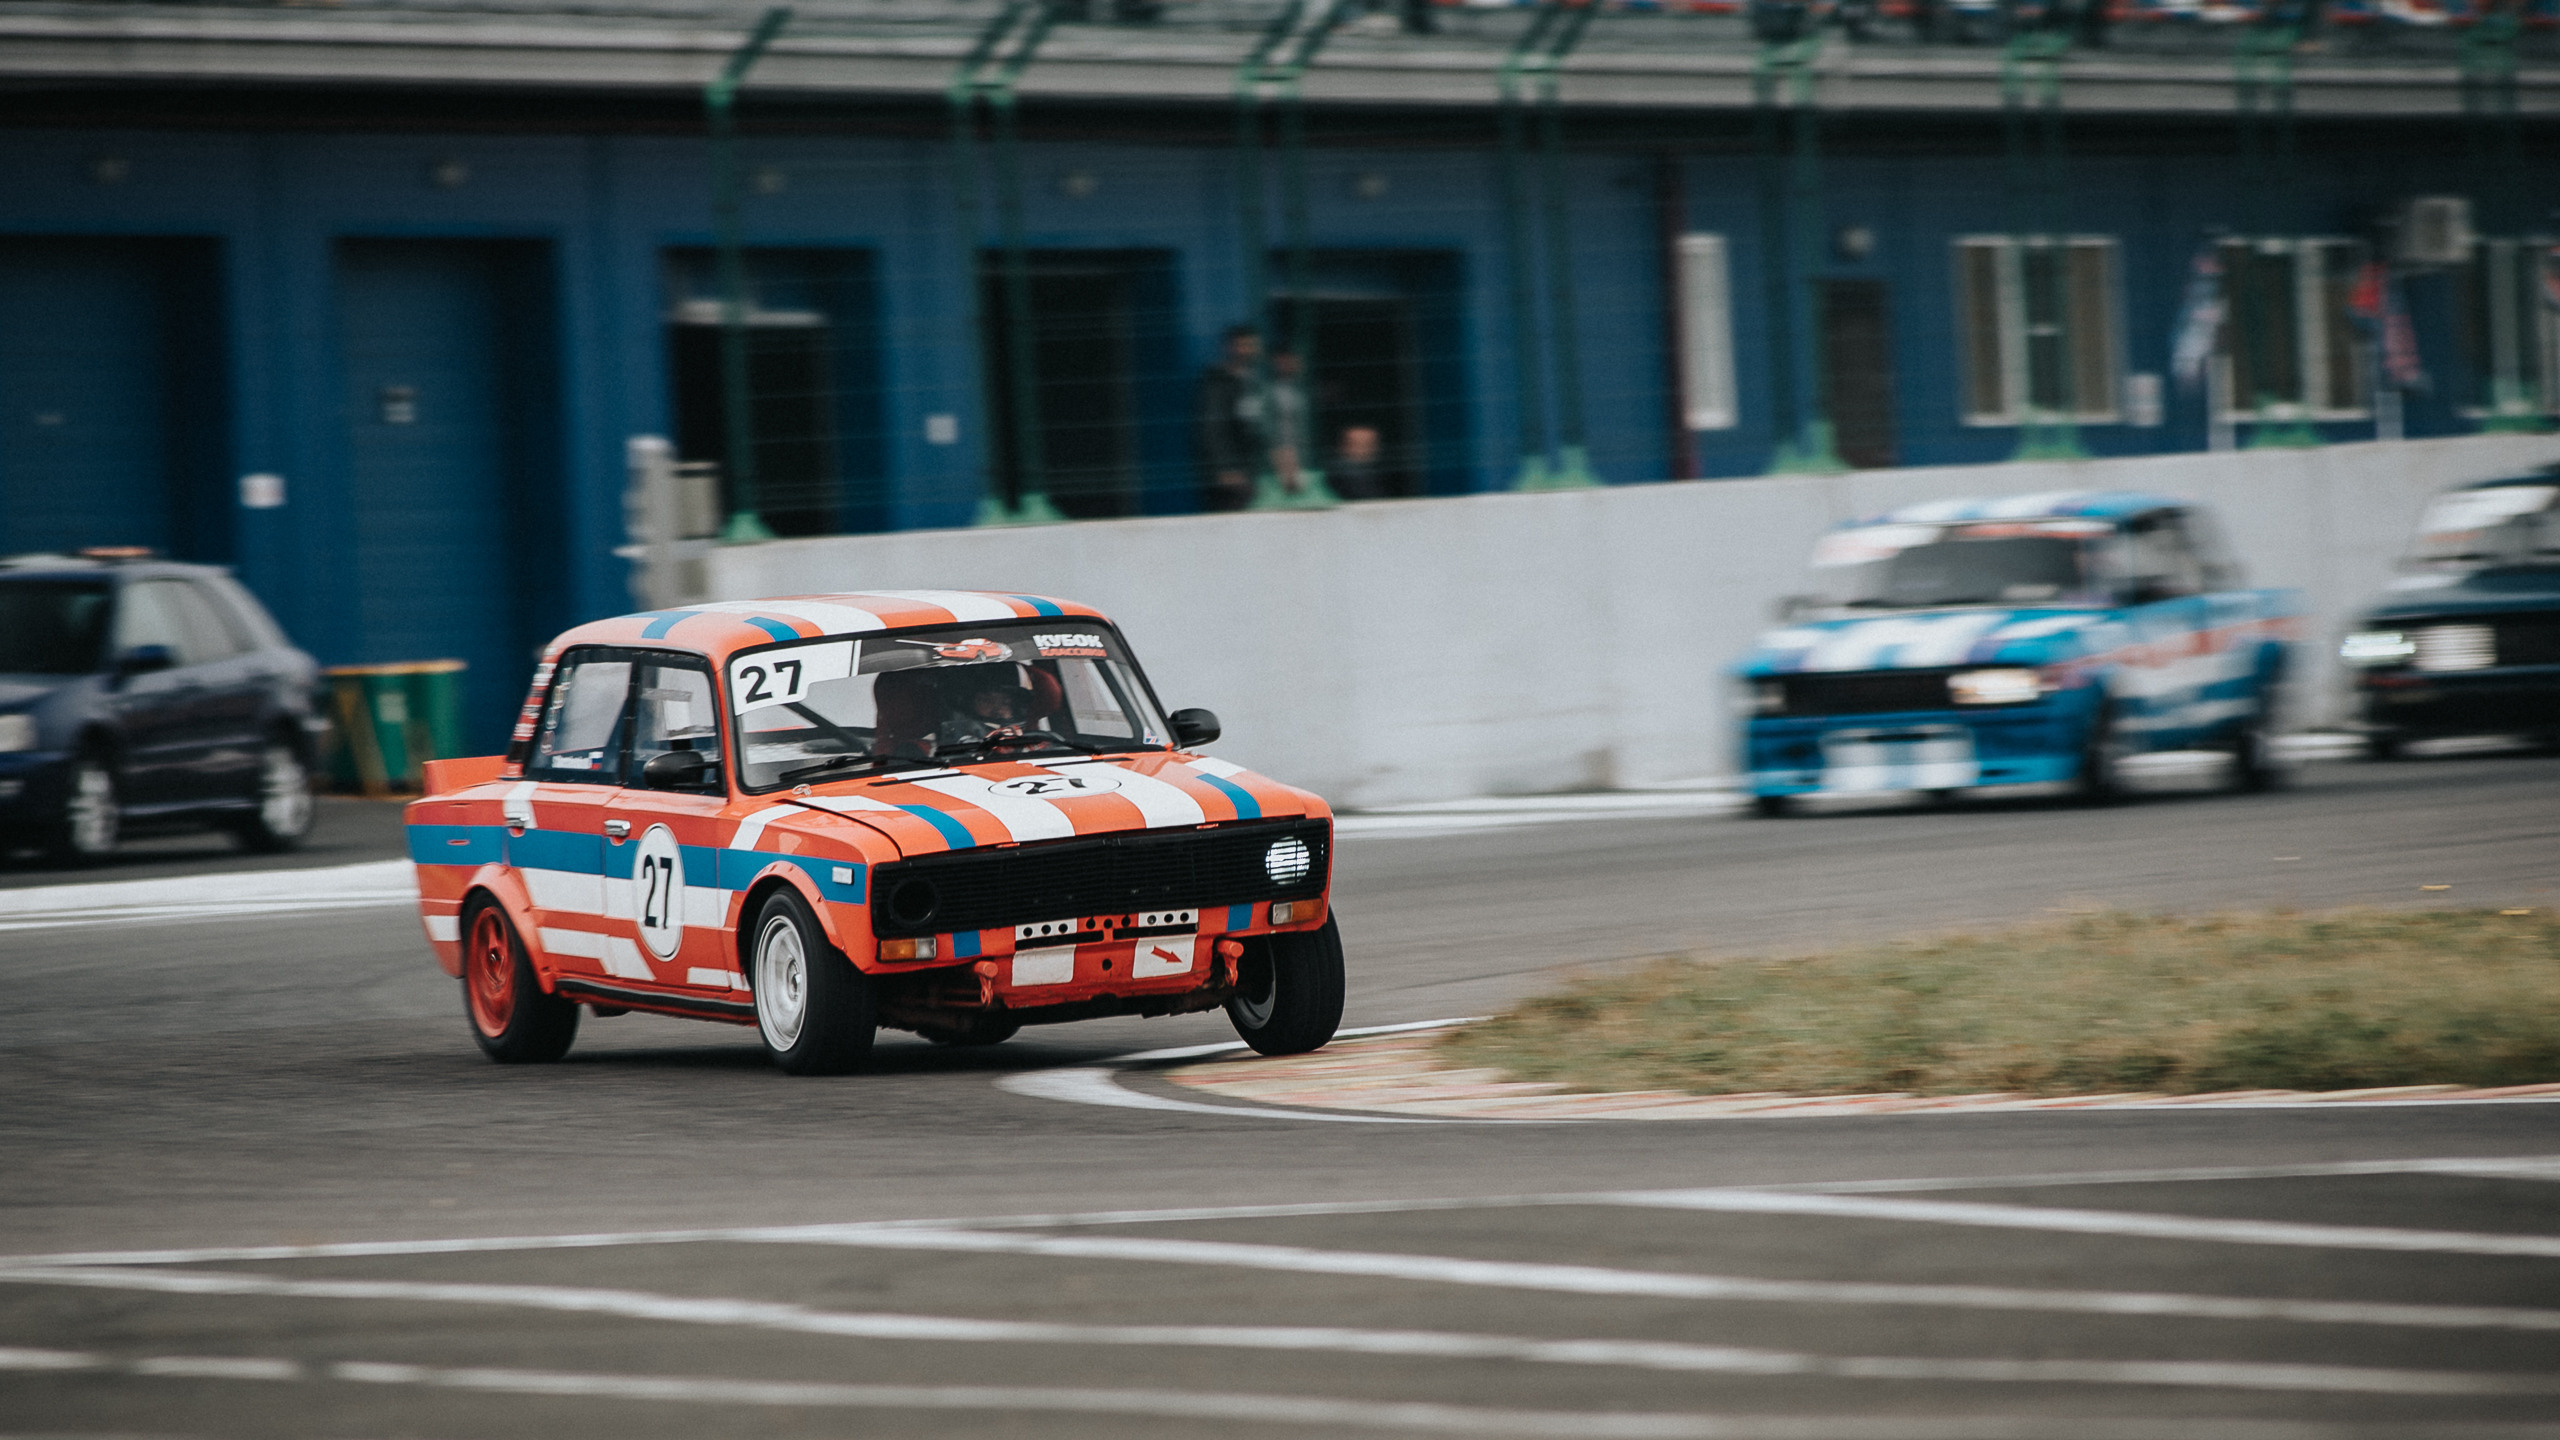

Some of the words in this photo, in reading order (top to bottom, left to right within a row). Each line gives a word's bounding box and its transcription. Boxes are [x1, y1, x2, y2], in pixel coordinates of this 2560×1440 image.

[1032, 633, 1104, 648] КУБОК
[739, 659, 802, 704] 27
[1006, 778, 1087, 795] 27
[642, 854, 673, 930] 27
